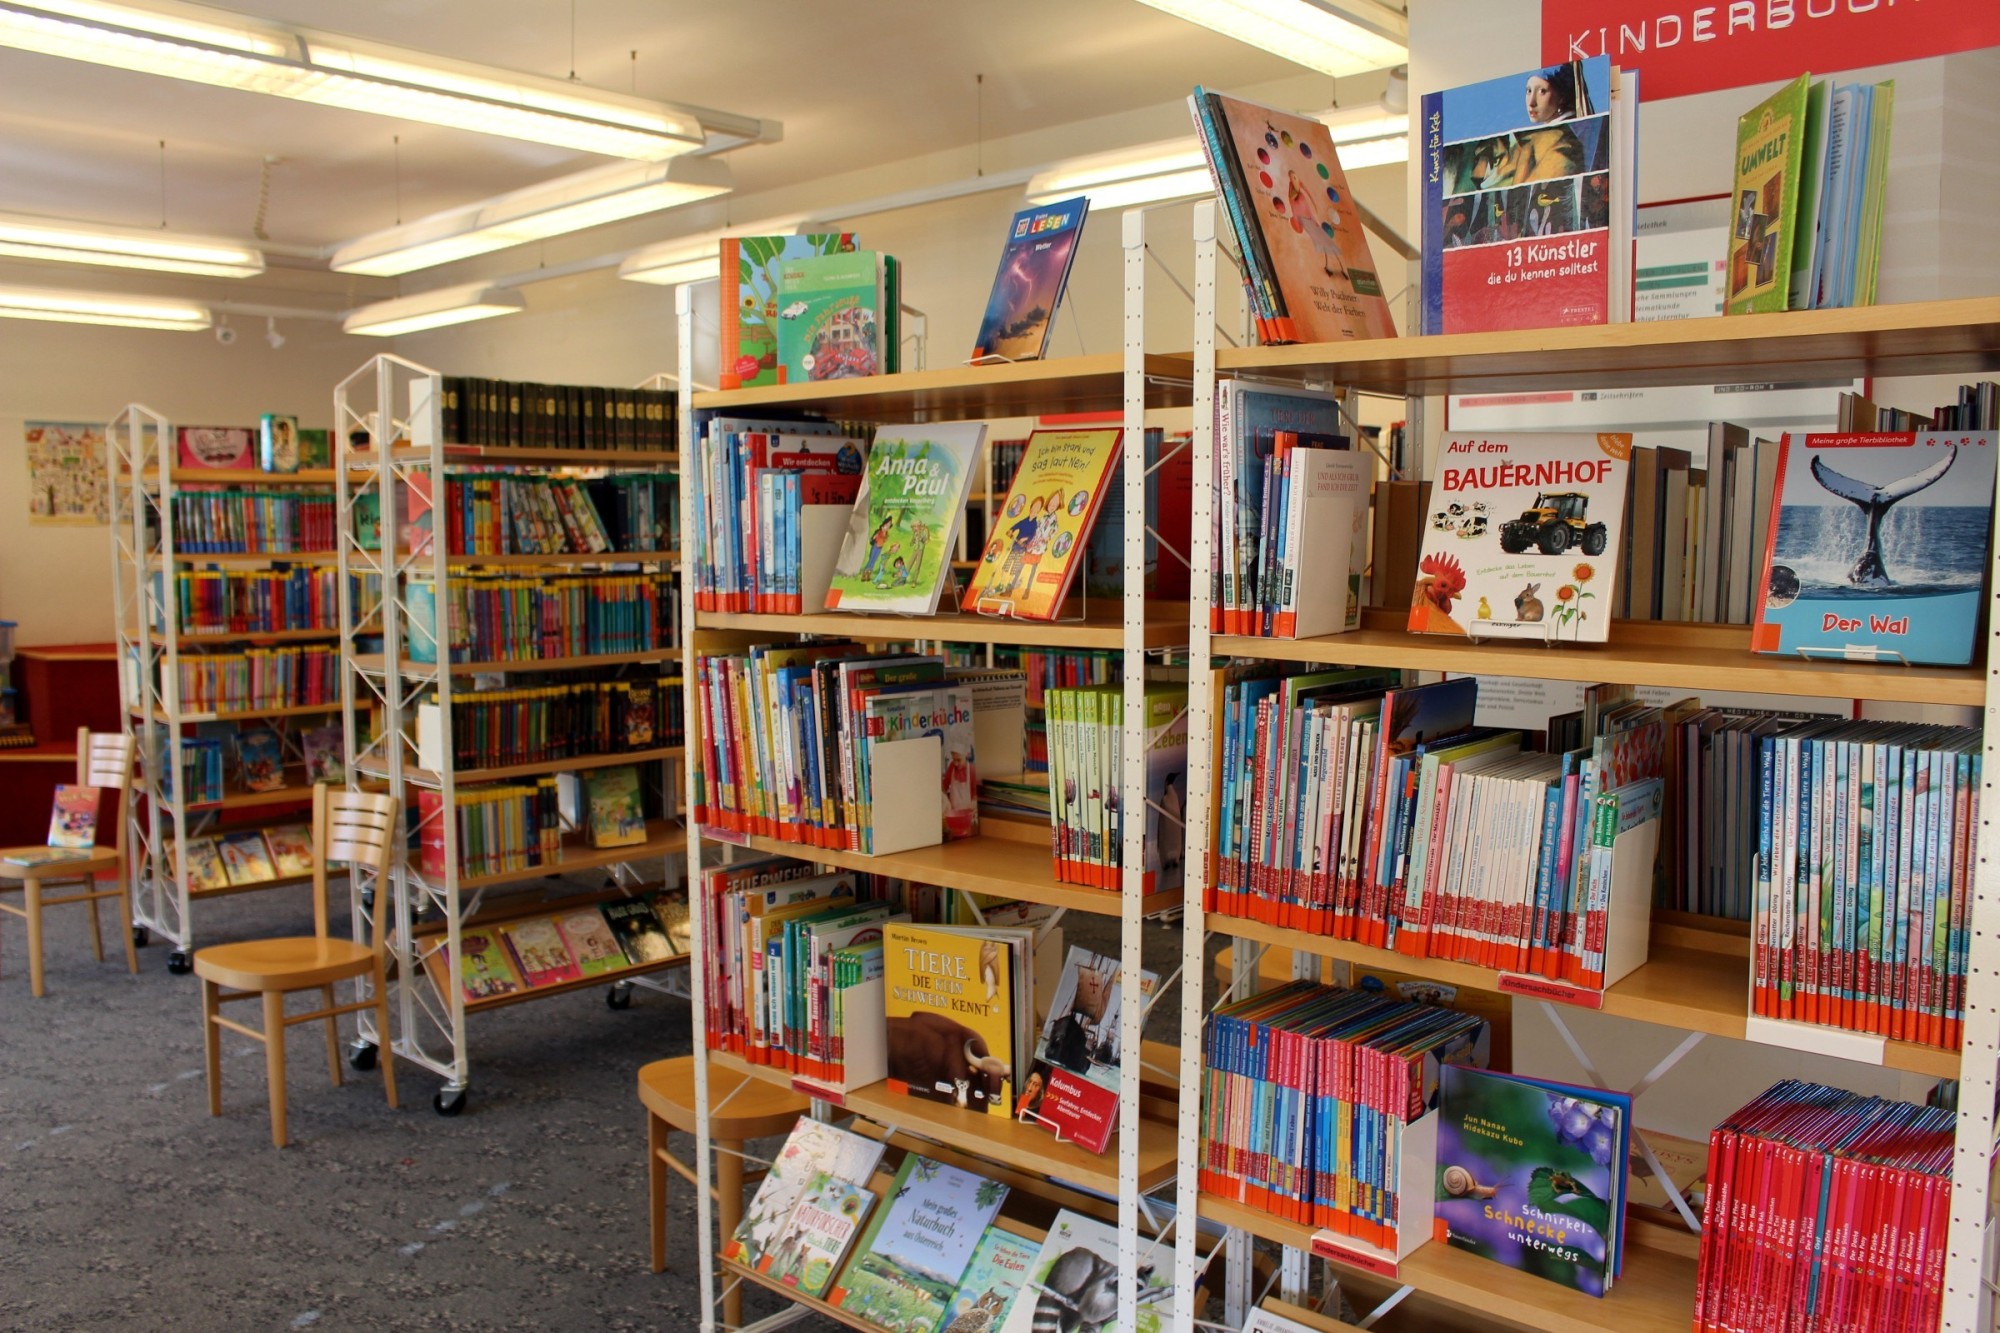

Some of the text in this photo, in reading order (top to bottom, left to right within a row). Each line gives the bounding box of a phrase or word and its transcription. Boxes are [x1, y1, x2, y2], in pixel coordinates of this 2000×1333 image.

[1742, 133, 1786, 176] UMWELT
[1430, 150, 1440, 183] Kunst
[1030, 213, 1070, 234] LESEN
[1507, 239, 1597, 267] 13 Künstler
[1488, 261, 1598, 285] die du kennen solltest
[1313, 301, 1331, 312] Welt
[1332, 304, 1342, 314] der
[1636, 303, 1680, 312] eimatkunde
[1221, 413, 1230, 433] Wie
[1448, 441, 1508, 453] Auf dem
[1812, 436, 1908, 446] Meine große Tierbibliothek
[1038, 448, 1050, 459] Ich
[1051, 445, 1062, 453] bin
[1083, 447, 1096, 456] und
[783, 458, 830, 467] Wir entdecken
[876, 455, 940, 477] Anna &
[1032, 460, 1047, 472] sag
[1050, 457, 1068, 469] laut
[903, 472, 949, 496] Paul
[1443, 460, 1612, 492] BAUERNHOF
[1822, 613, 1909, 635] Der Wal
[884, 674, 897, 682] Der
[890, 706, 970, 731] Kinderküche
[1763, 751, 1771, 768] Wald
[1762, 780, 1770, 797] Tiere
[1546, 802, 1556, 826] Große
[1837, 792, 1845, 819] Freunde
[1761, 811, 1769, 825] und
[1544, 828, 1552, 844] und
[1761, 827, 1769, 844] Fuchs
[1760, 846, 1768, 866] kleine
[1760, 868, 1768, 880] Der
[912, 974, 963, 994] DIE KEIN
[1502, 979, 1576, 999] Kindersachbücher
[811, 983, 819, 1020] Baustelle
[892, 986, 991, 1016] SCHWEIN KENNT
[1050, 1076, 1082, 1097] Kolumbus
[1464, 1114, 1506, 1132] Jun Nanao
[1463, 1123, 1524, 1146] Hidekazu Kubo
[923, 1199, 936, 1210] Mein
[908, 1210, 955, 1238] Naturbuch
[1484, 1205, 1566, 1244] Schnecke
[1522, 1204, 1593, 1234] Schnirkel-
[914, 1232, 944, 1251] Österreich
[1508, 1230, 1578, 1262] unterwegs
[992, 1254, 1025, 1271] Die Eulen
[1315, 1243, 1376, 1268] Kindersachbücher
